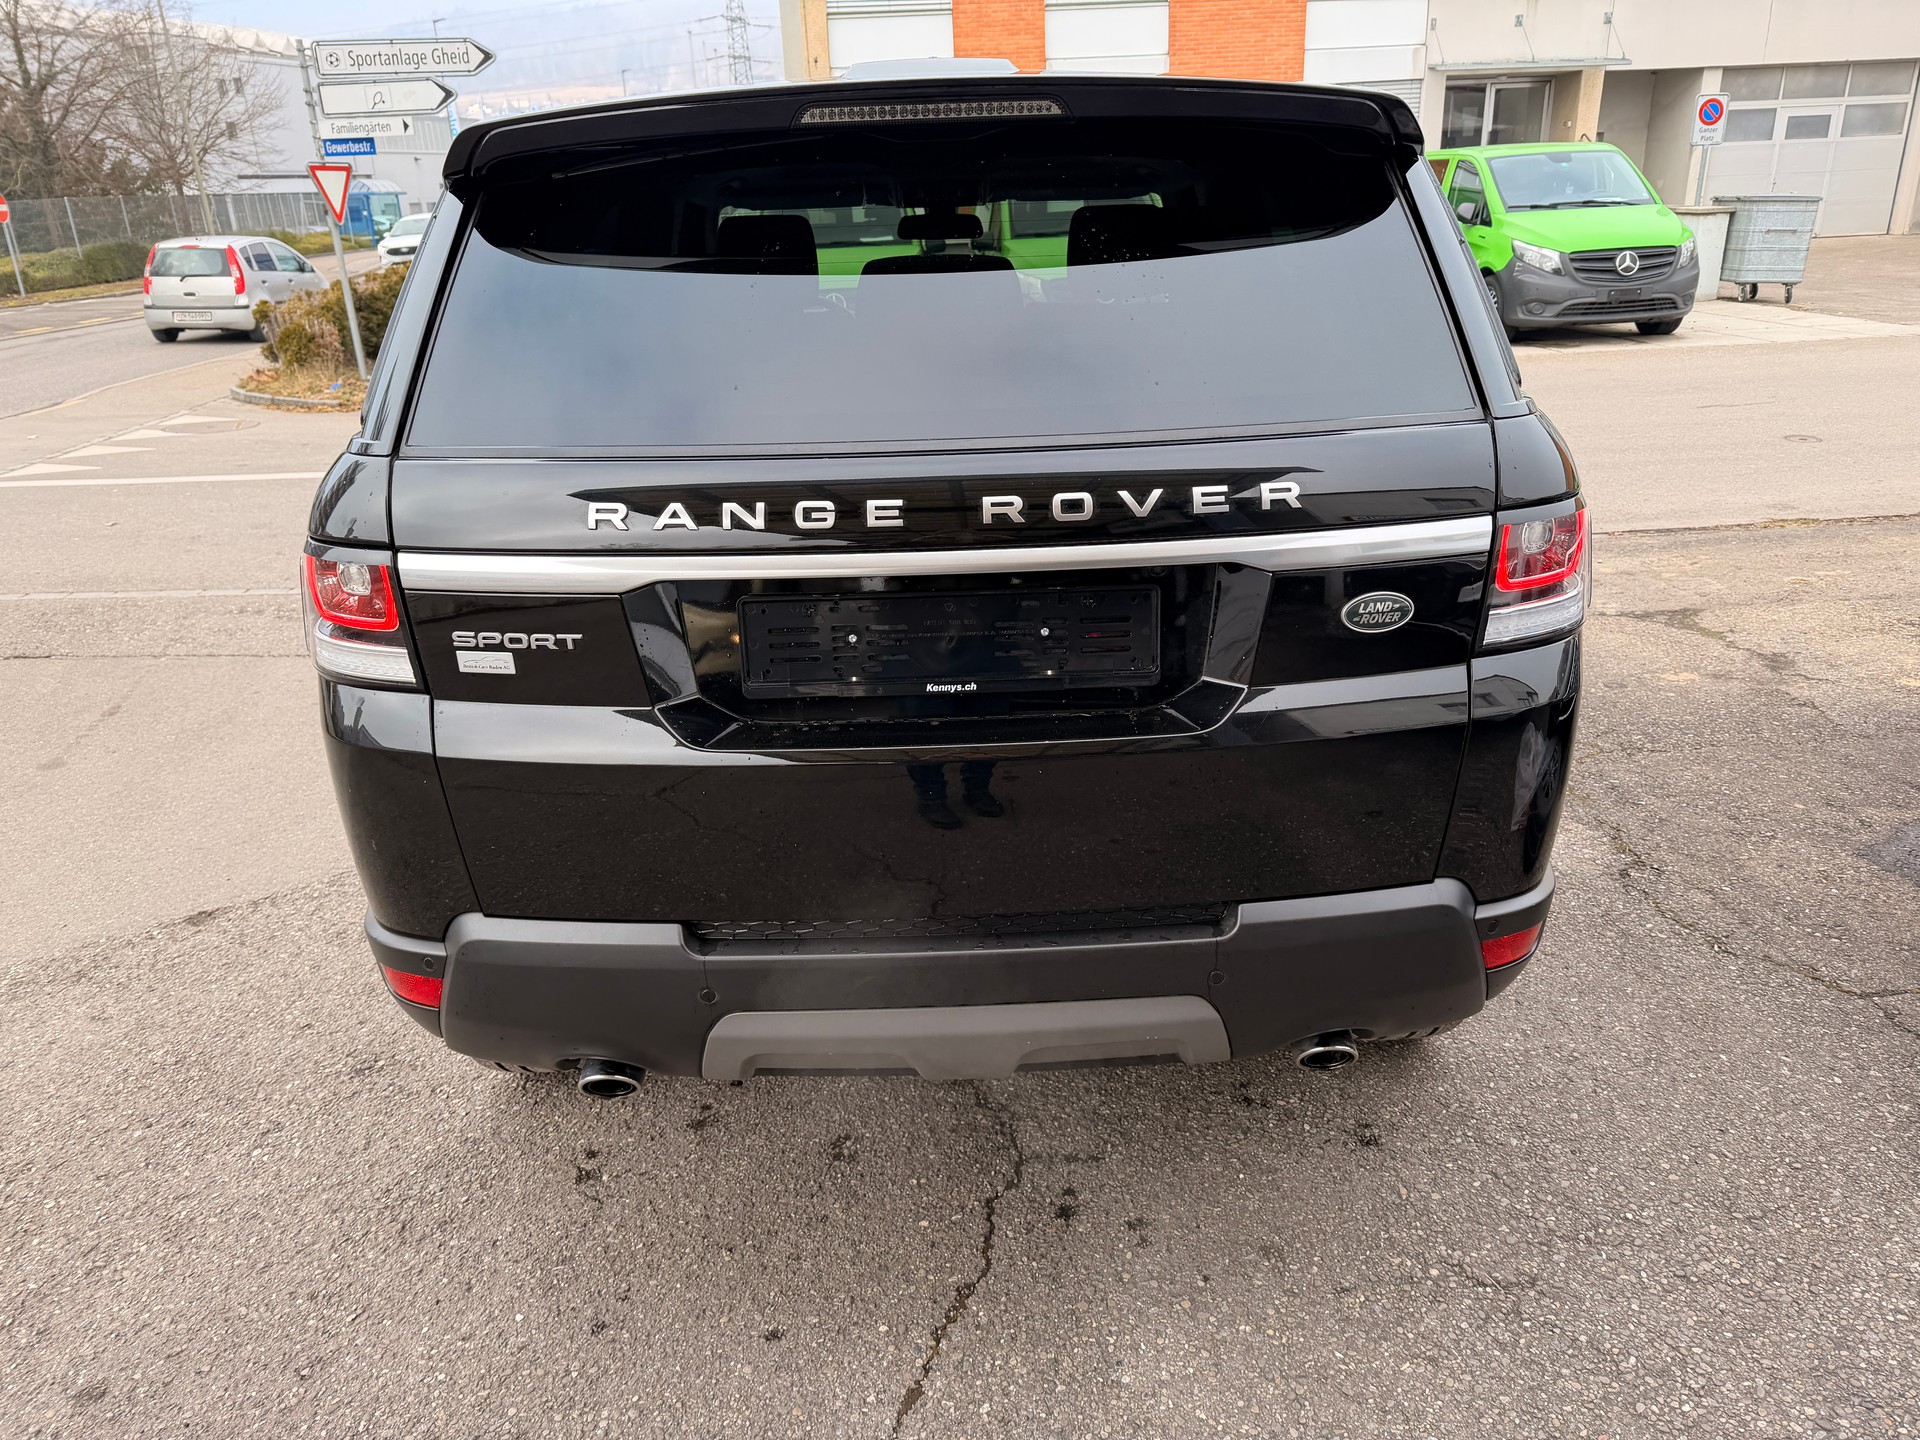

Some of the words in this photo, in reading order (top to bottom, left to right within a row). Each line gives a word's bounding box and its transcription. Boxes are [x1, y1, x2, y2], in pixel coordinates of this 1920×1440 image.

[347, 48, 428, 71] Sportanlage
[431, 46, 470, 65] Gheid
[330, 121, 392, 136] Familiengärten
[325, 140, 375, 154] Gewerbestr.
[587, 499, 904, 531] RANGE
[982, 481, 1303, 525] ROVER
[1358, 601, 1393, 614] LAND
[1360, 611, 1402, 624] ROVER
[451, 630, 583, 650] SPORT
[926, 682, 977, 693] Kennys.ch
